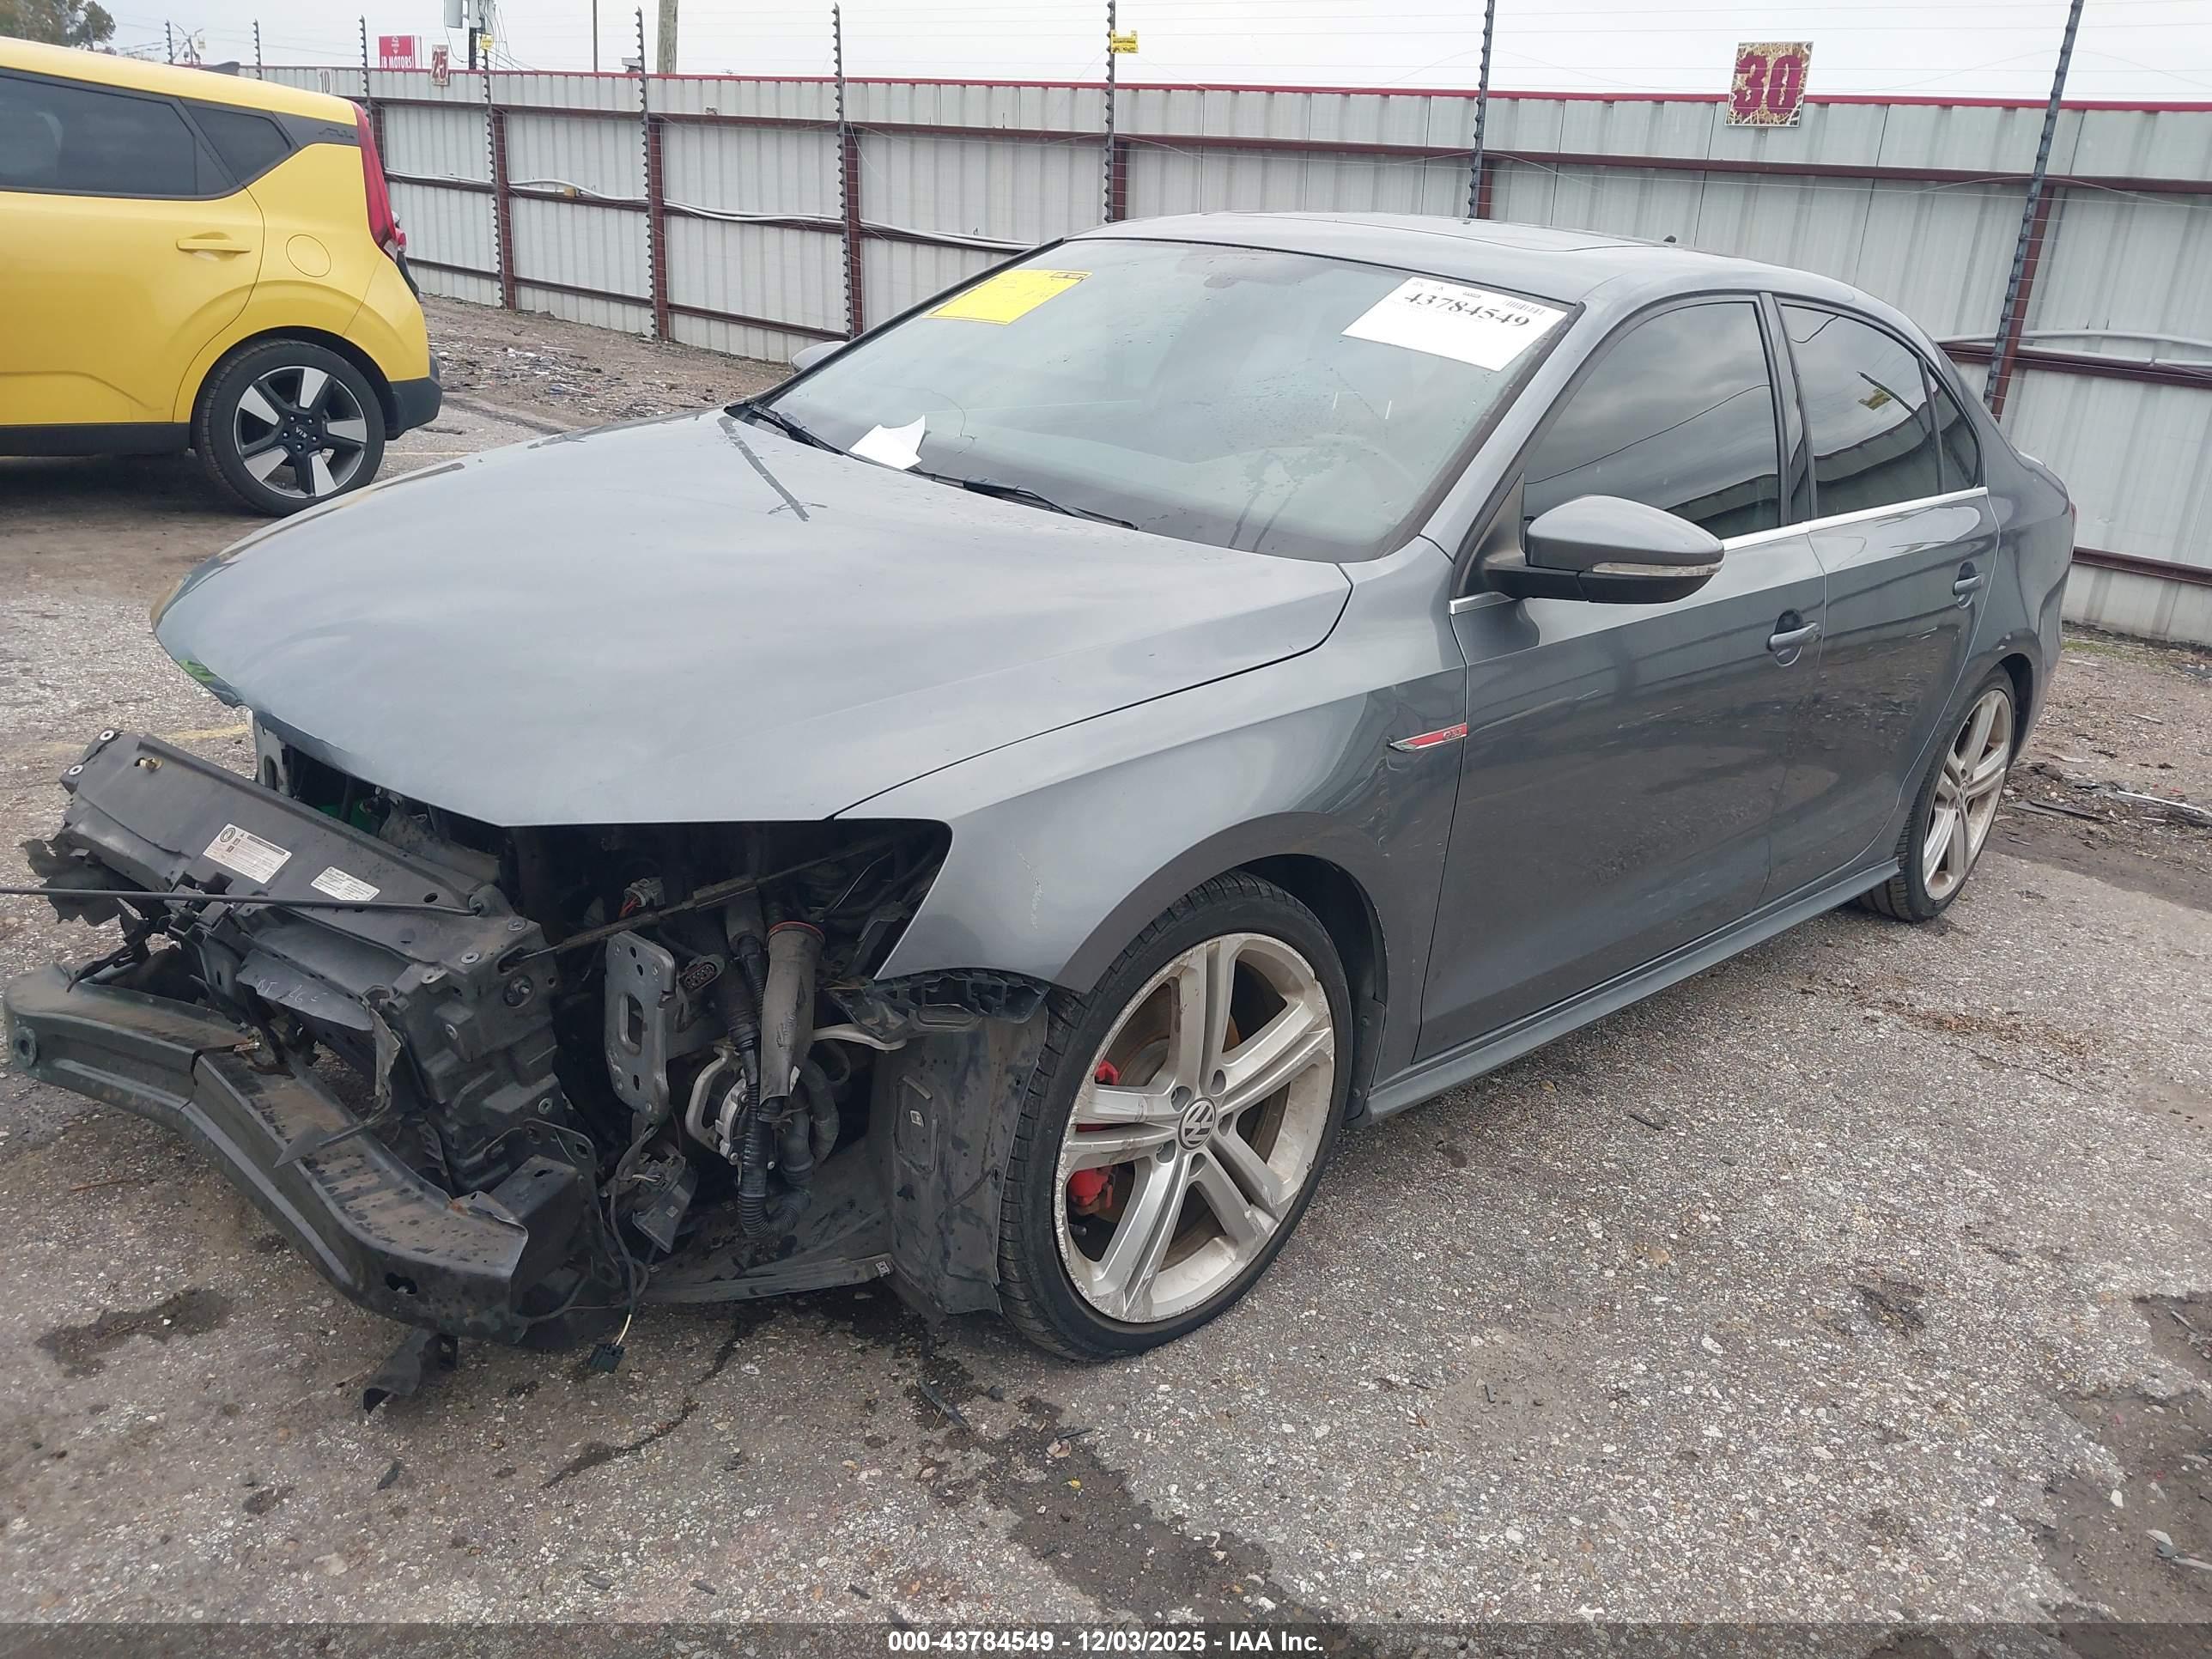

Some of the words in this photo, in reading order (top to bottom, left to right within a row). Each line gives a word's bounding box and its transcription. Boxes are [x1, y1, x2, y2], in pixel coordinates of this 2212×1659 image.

[388, 56, 412, 69] MOTORS
[432, 51, 447, 79] 25
[319, 70, 330, 94] 10
[1732, 52, 1802, 118] 30
[1404, 293, 1530, 327] 43784549
